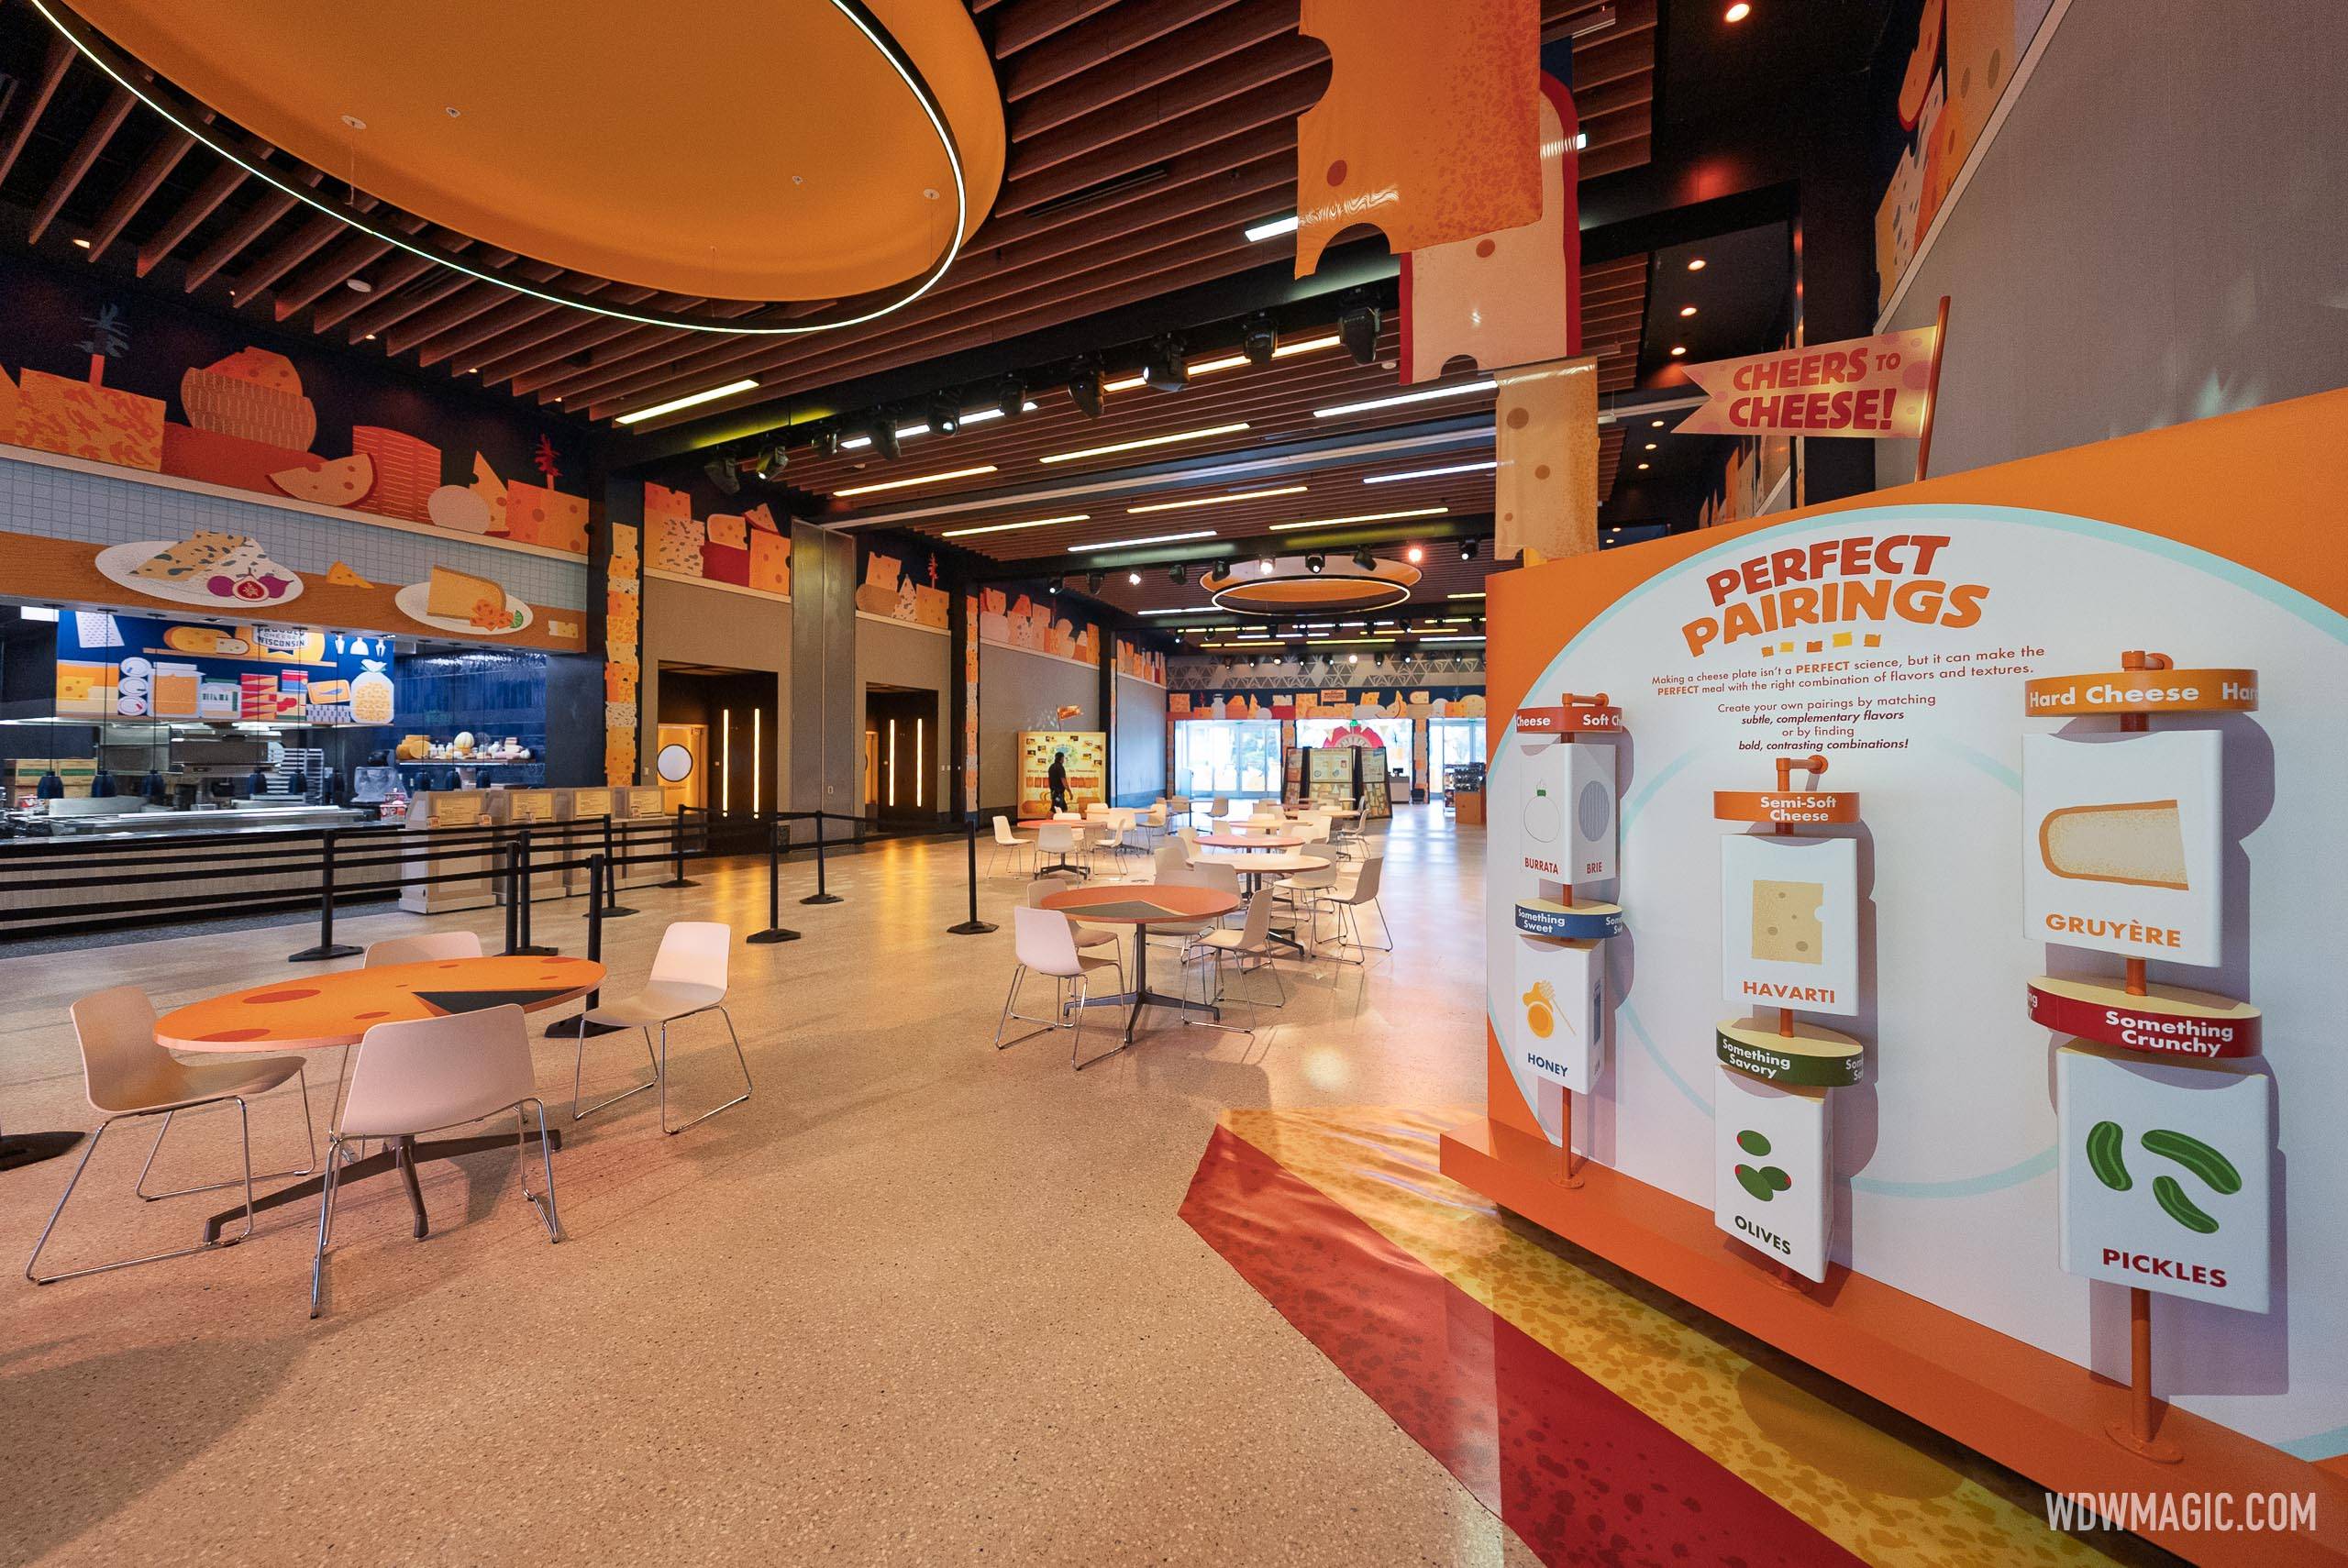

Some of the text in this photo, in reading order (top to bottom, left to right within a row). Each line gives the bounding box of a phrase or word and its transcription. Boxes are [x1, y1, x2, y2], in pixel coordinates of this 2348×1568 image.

[1733, 348, 1901, 392] CHEERS TO
[1729, 388, 1897, 430] CHEESE!
[1706, 535, 1951, 607] PERFECT
[1681, 579, 1990, 657] PAIRINGS
[1652, 675, 1685, 686] Making
[1697, 672, 1728, 681] cheese
[1733, 669, 1757, 680] plate
[1796, 661, 1850, 674] PERFECT
[1855, 660, 1902, 670] science,
[1908, 655, 1928, 666] but
[1933, 654, 1941, 664] it
[1946, 654, 1970, 663] can
[1977, 647, 2015, 660] make
[2021, 646, 2044, 657] the
[1658, 664, 2033, 696] PERFECT meal with the right combination of flavors and textures.
[1718, 703, 1750, 712] Create
[1754, 703, 1778, 713] your
[1808, 699, 1854, 712] pairings
[1857, 697, 1873, 708] by
[1877, 694, 1936, 707] matching
[2030, 683, 2199, 708] Hard Cheese
[1516, 715, 1551, 726] Cheese
[1583, 713, 1609, 726] Soft
[1742, 710, 1904, 725] subtle, complementary flavors
[1798, 726, 1809, 738] by
[1814, 725, 1855, 737] finding
[1738, 738, 1909, 752] bold, contrasting combinations!
[1760, 795, 1836, 809] Semi-Soft
[1769, 810, 1829, 822] Cheese
[1524, 857, 1558, 875] BURRATA
[1587, 862, 1602, 875] BRIE
[1518, 908, 1566, 927] Something
[1523, 920, 1553, 933] Sweet
[2045, 913, 2181, 948] GRUYÈRE
[1744, 980, 1835, 1003] HAVARTI
[2105, 1010, 2233, 1043] Something
[1722, 1038, 1791, 1071] Something
[2121, 1029, 2221, 1058] Crunchy
[1528, 1053, 1568, 1077] HONEY
[1729, 1053, 1778, 1079] Savory
[1734, 1215, 1791, 1255] OLIVES
[2102, 1248, 2228, 1288] PICKLES
